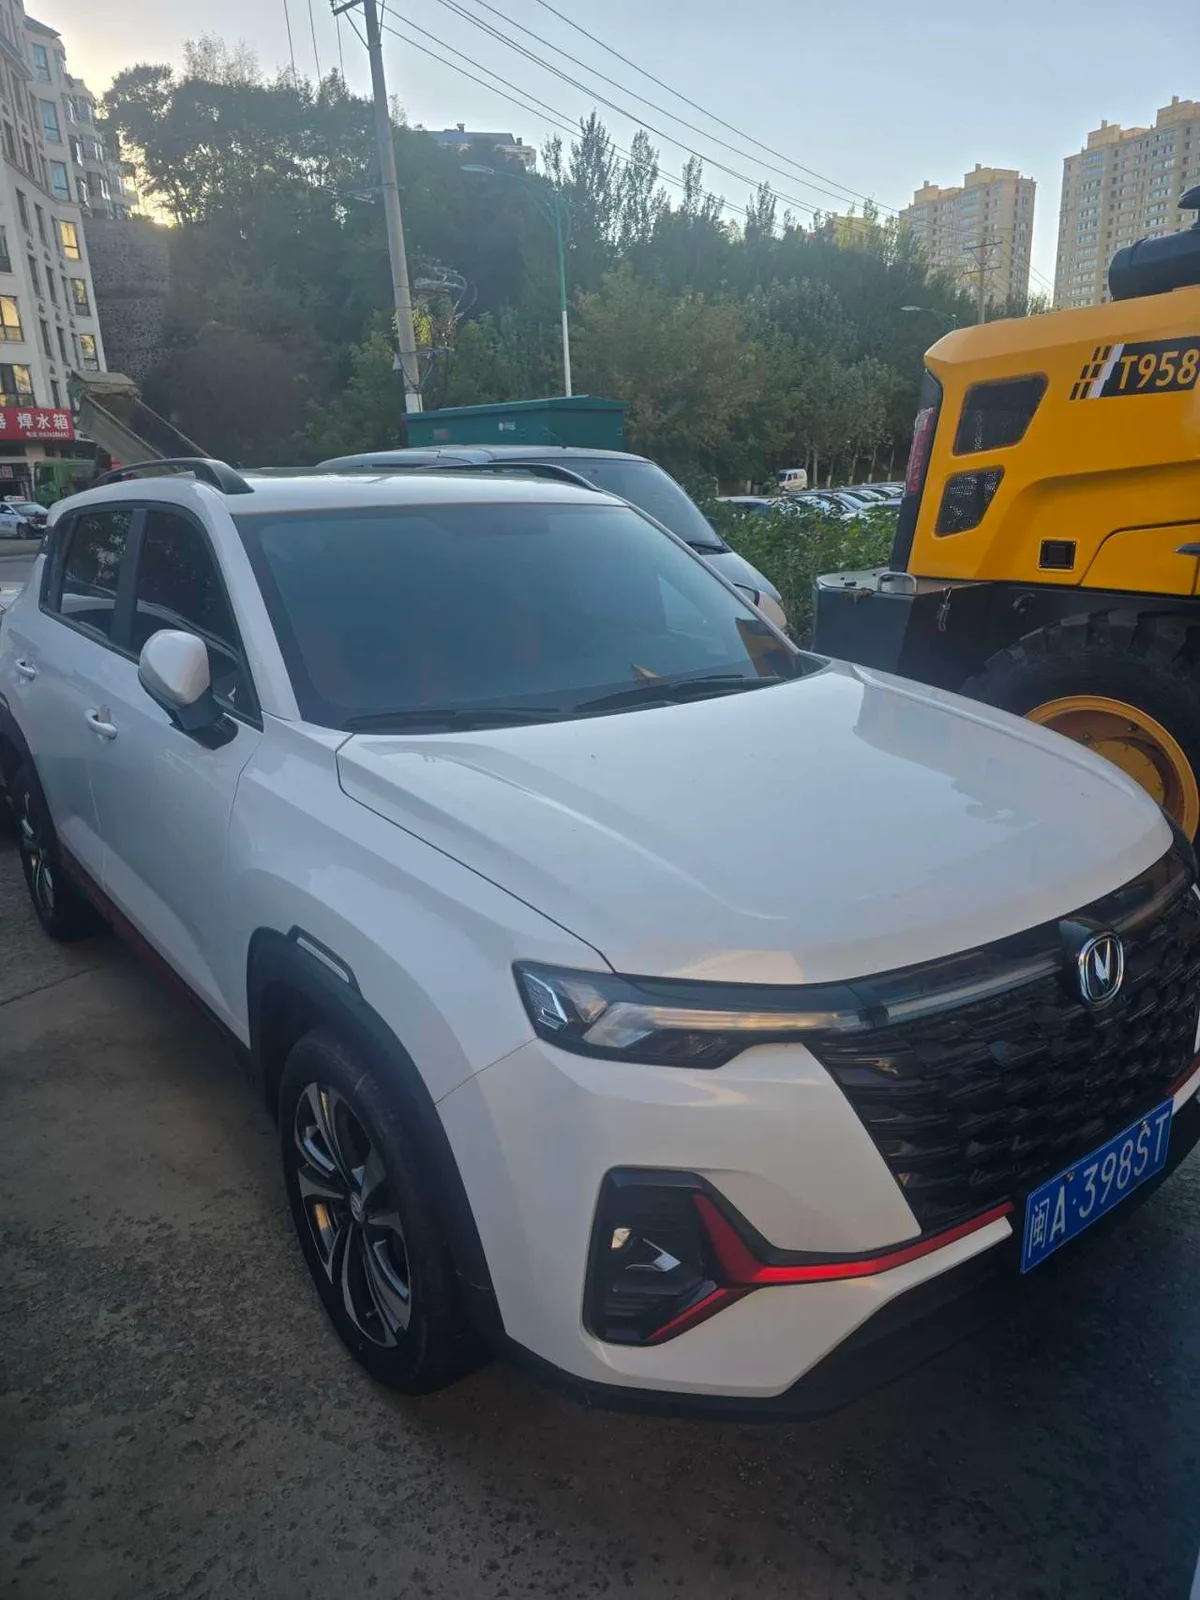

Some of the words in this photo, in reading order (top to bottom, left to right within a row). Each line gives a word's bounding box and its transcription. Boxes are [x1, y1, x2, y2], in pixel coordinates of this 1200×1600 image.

[1119, 349, 1200, 390] T958
[17, 412, 69, 430] 焊水箱
